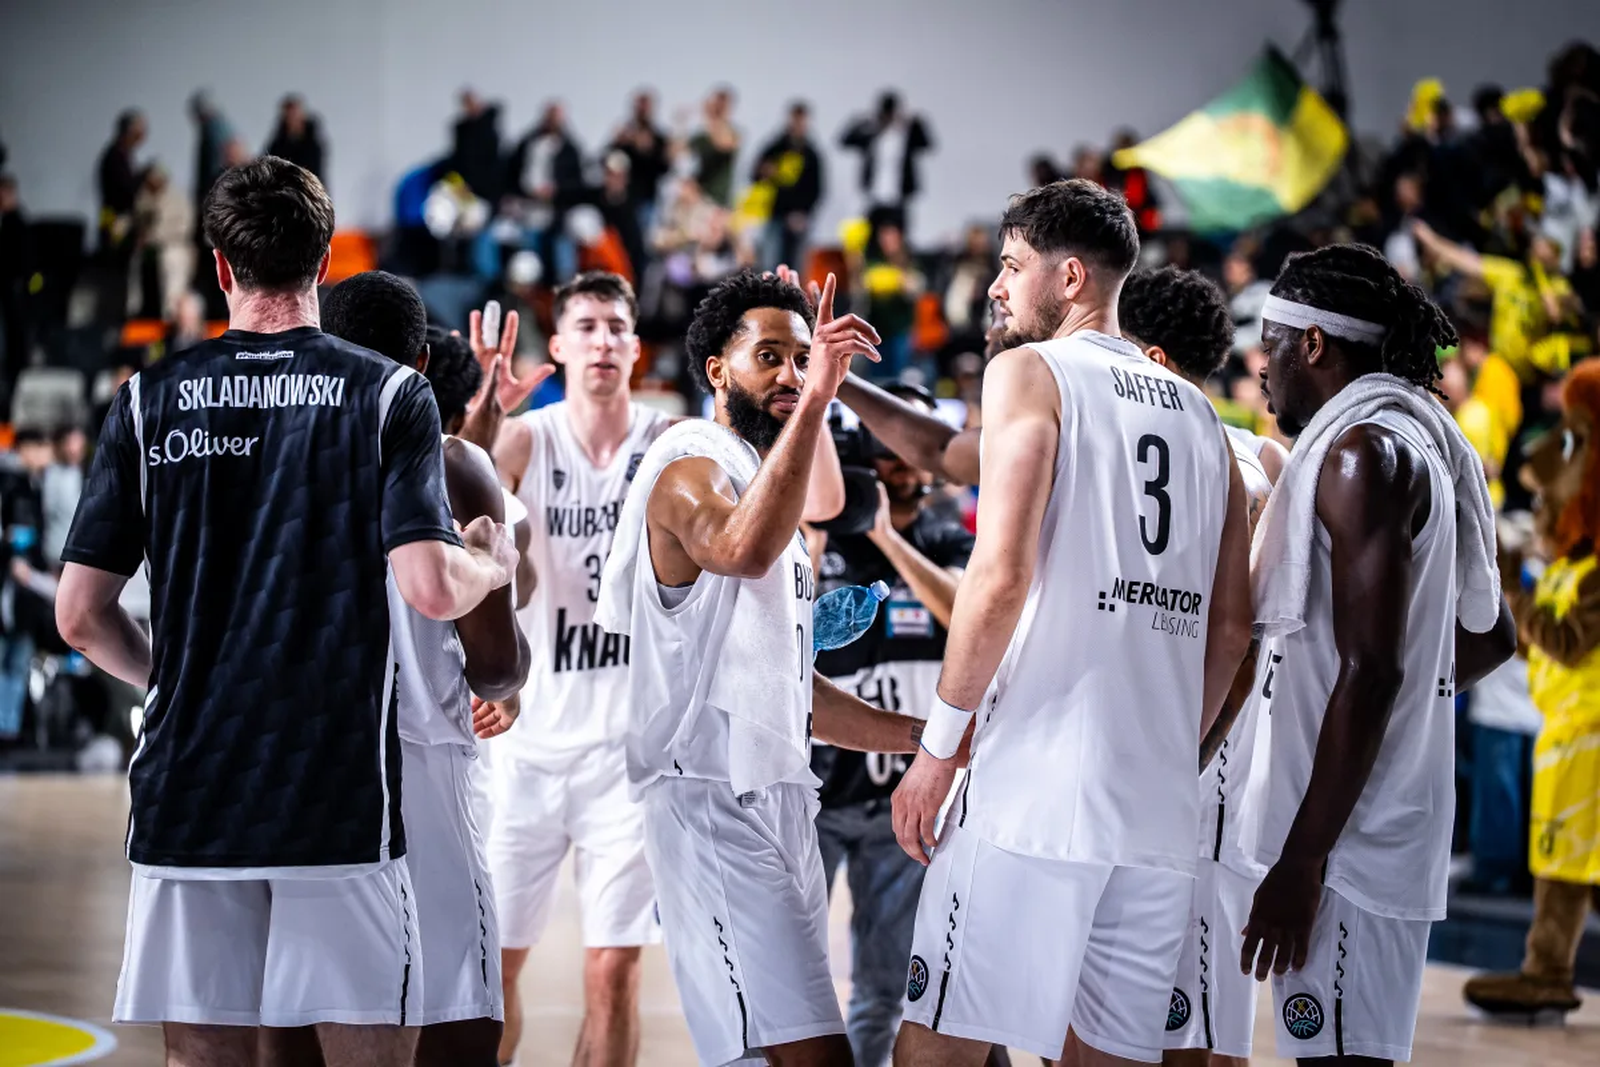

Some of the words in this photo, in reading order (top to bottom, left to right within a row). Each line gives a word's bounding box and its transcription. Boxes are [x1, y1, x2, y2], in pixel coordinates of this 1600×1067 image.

[177, 373, 345, 412] SKLADANOWSKI
[1110, 365, 1185, 412] SAFFER
[148, 427, 260, 467] s.Oliver
[1137, 433, 1172, 556] 3
[546, 499, 625, 538] WÜRZB
[584, 553, 606, 603] 3
